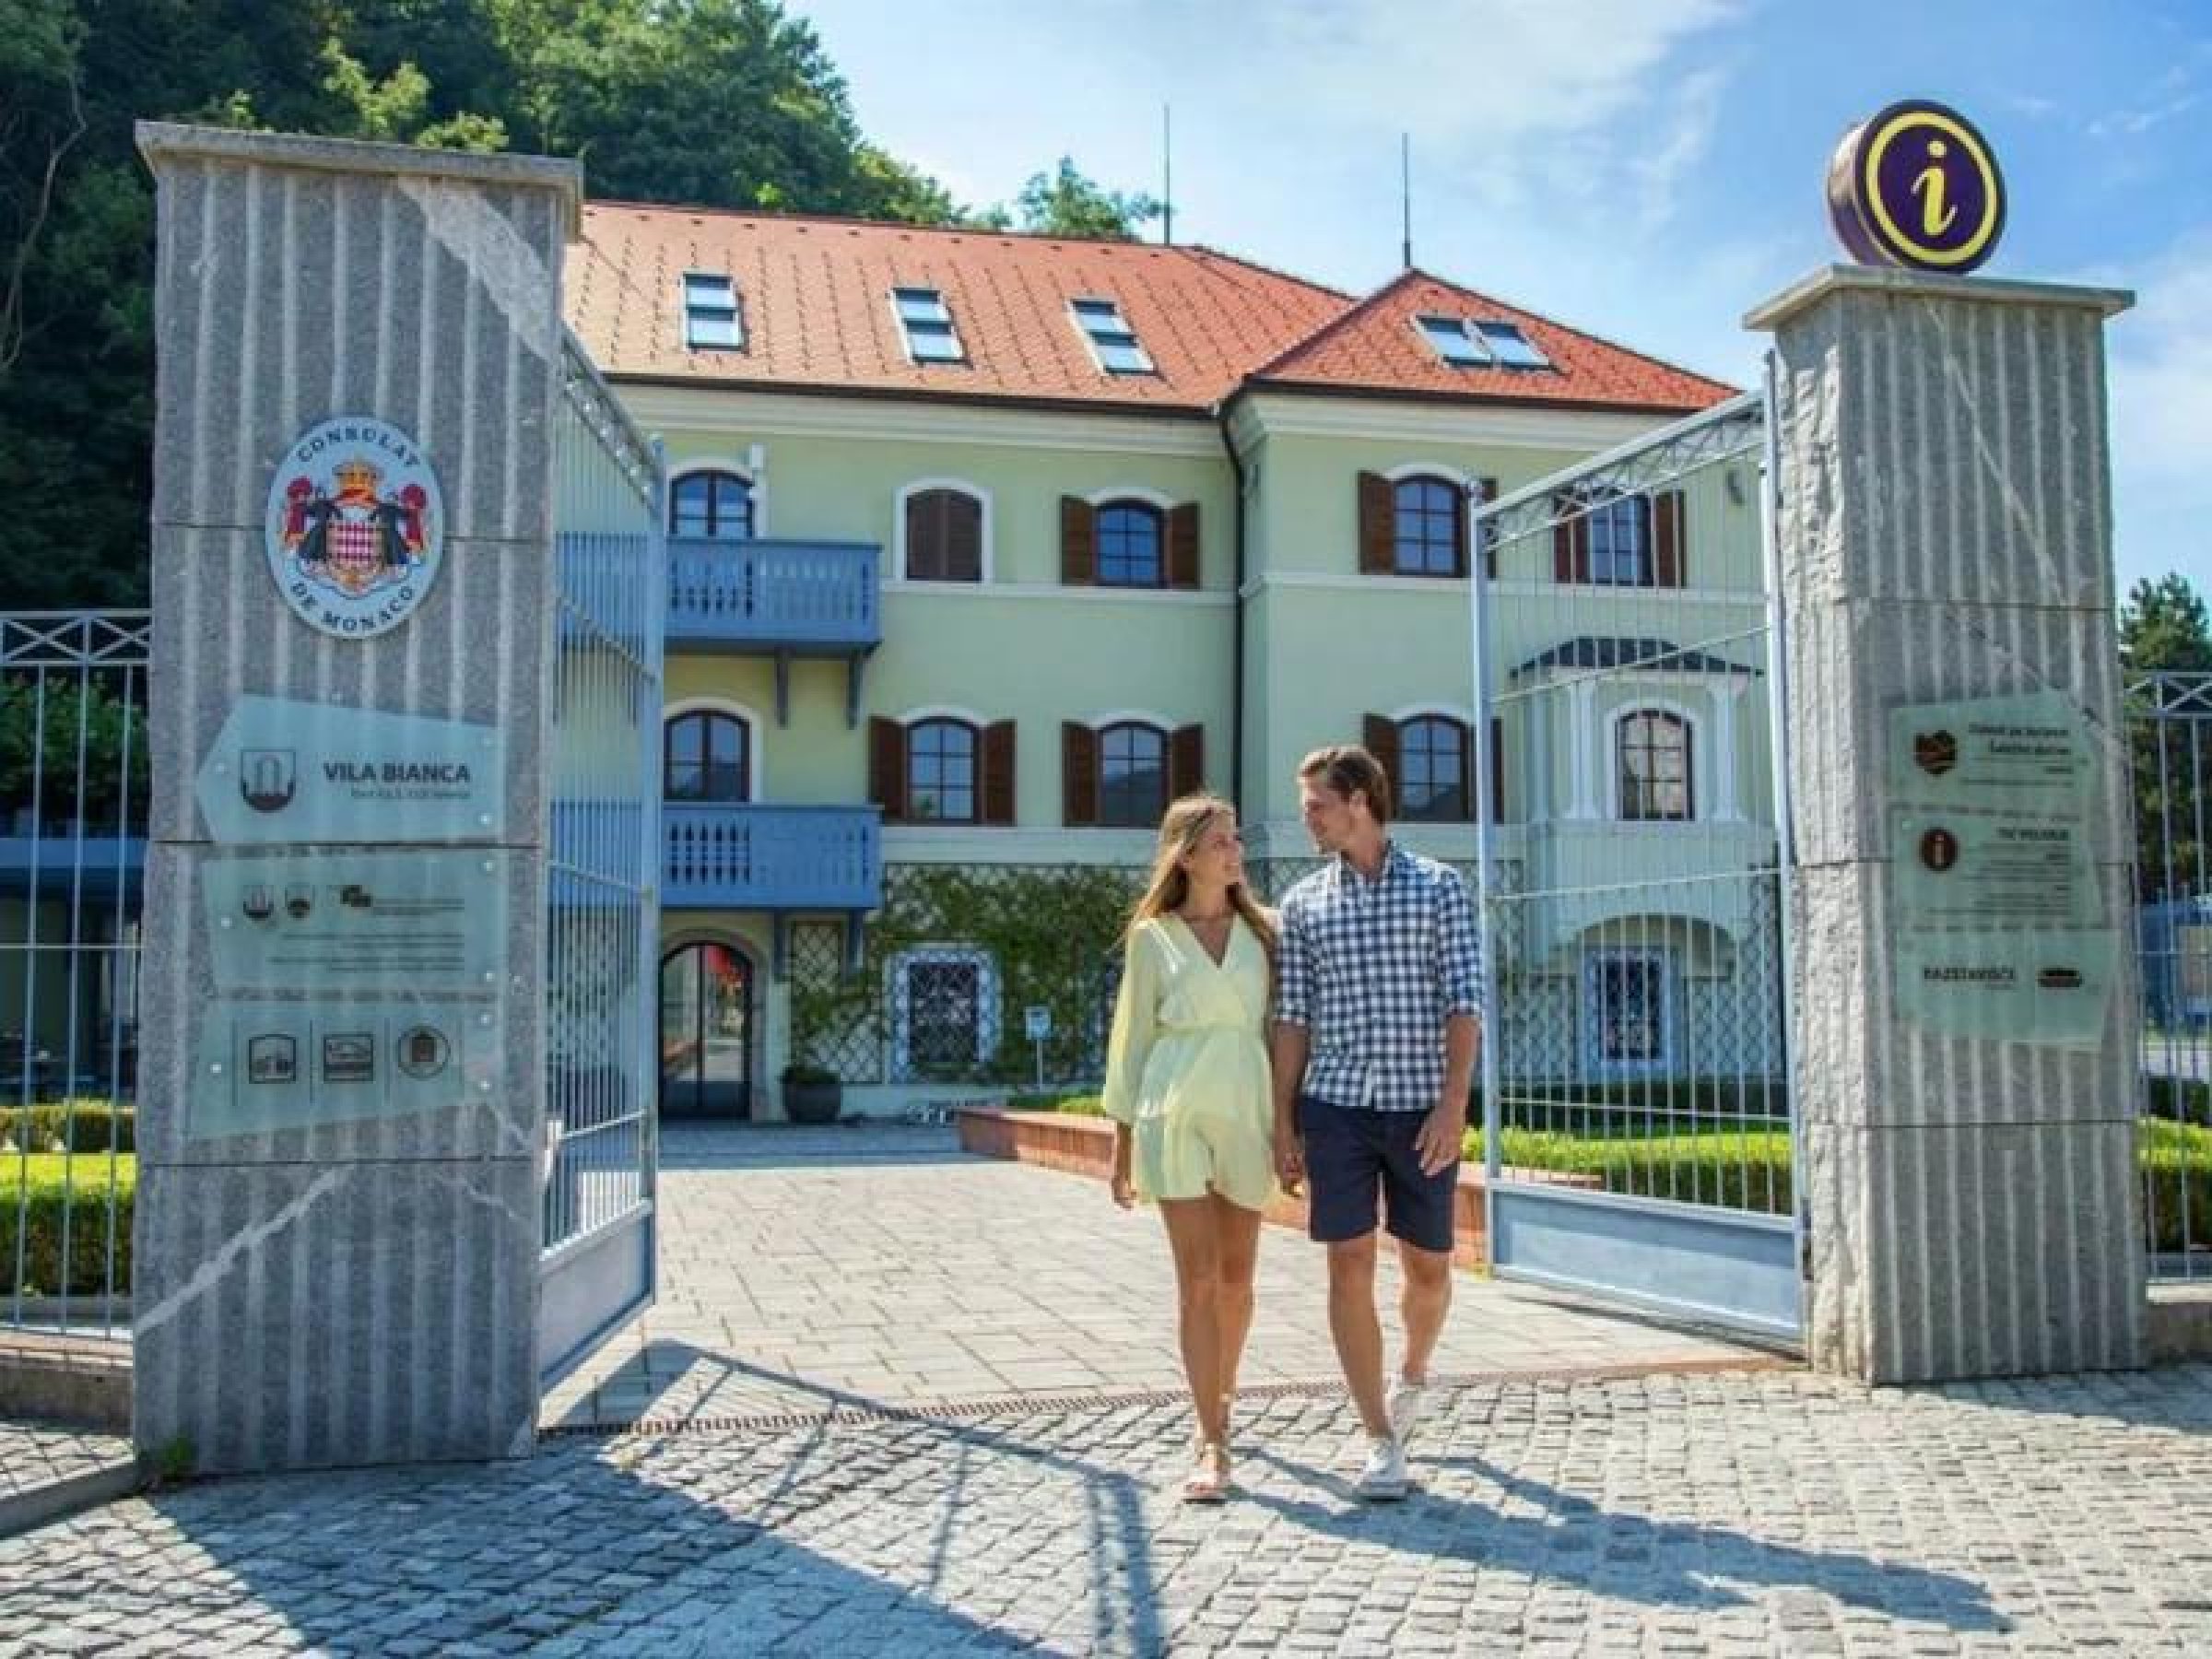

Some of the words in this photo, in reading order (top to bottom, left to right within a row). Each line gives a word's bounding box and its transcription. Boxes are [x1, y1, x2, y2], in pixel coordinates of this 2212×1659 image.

[297, 427, 419, 466] CONSULAT
[290, 582, 317, 609] DE
[324, 585, 413, 631] MONACO
[324, 762, 376, 783] VILA
[382, 762, 471, 783] BIANCA
